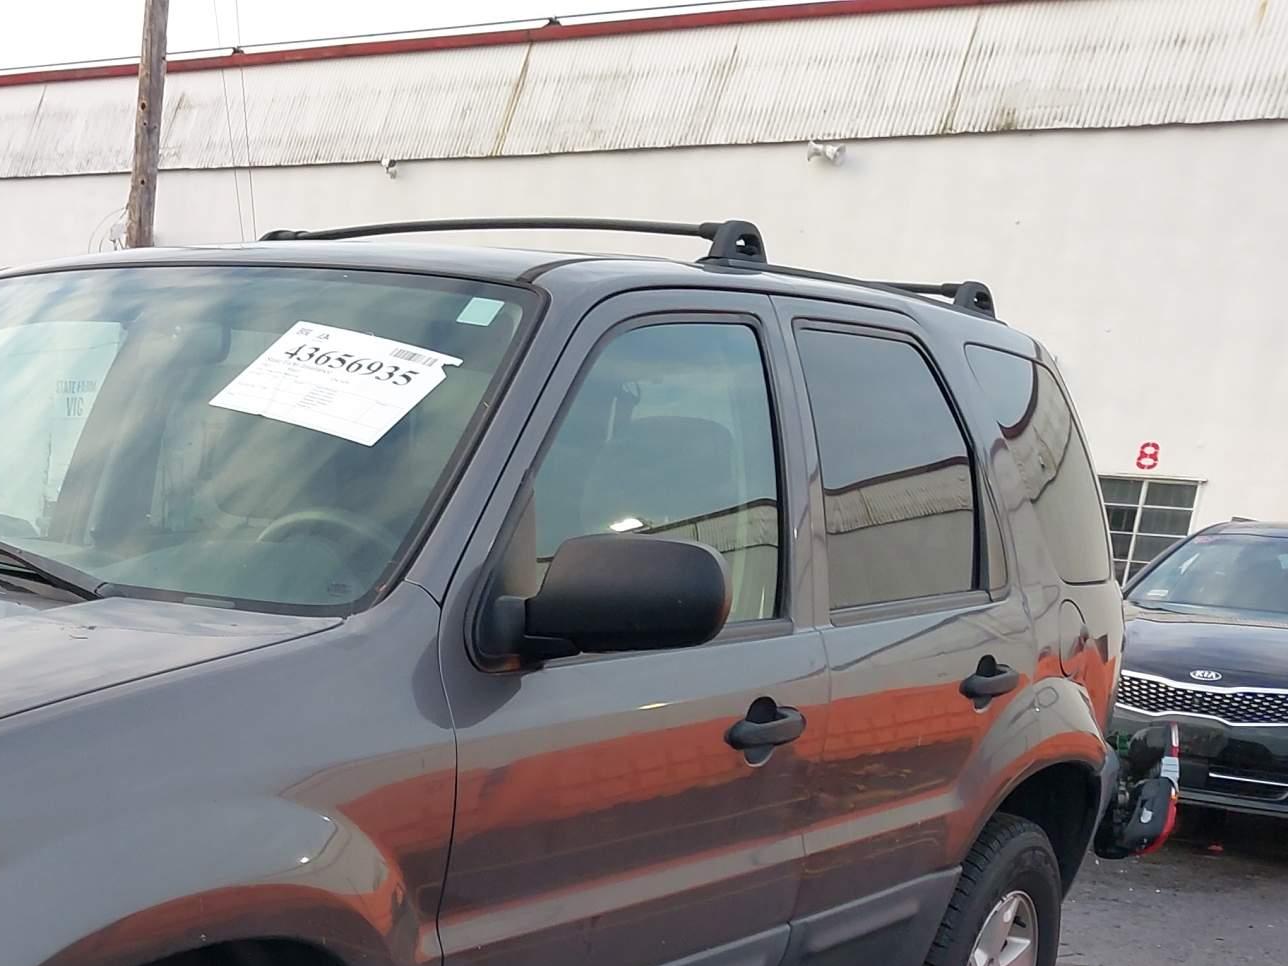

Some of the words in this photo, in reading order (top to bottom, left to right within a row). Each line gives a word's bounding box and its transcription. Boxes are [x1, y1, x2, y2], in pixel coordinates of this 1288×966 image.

[284, 344, 420, 386] 43656935
[1136, 442, 1160, 470] 8
[1195, 670, 1216, 680] KIA
